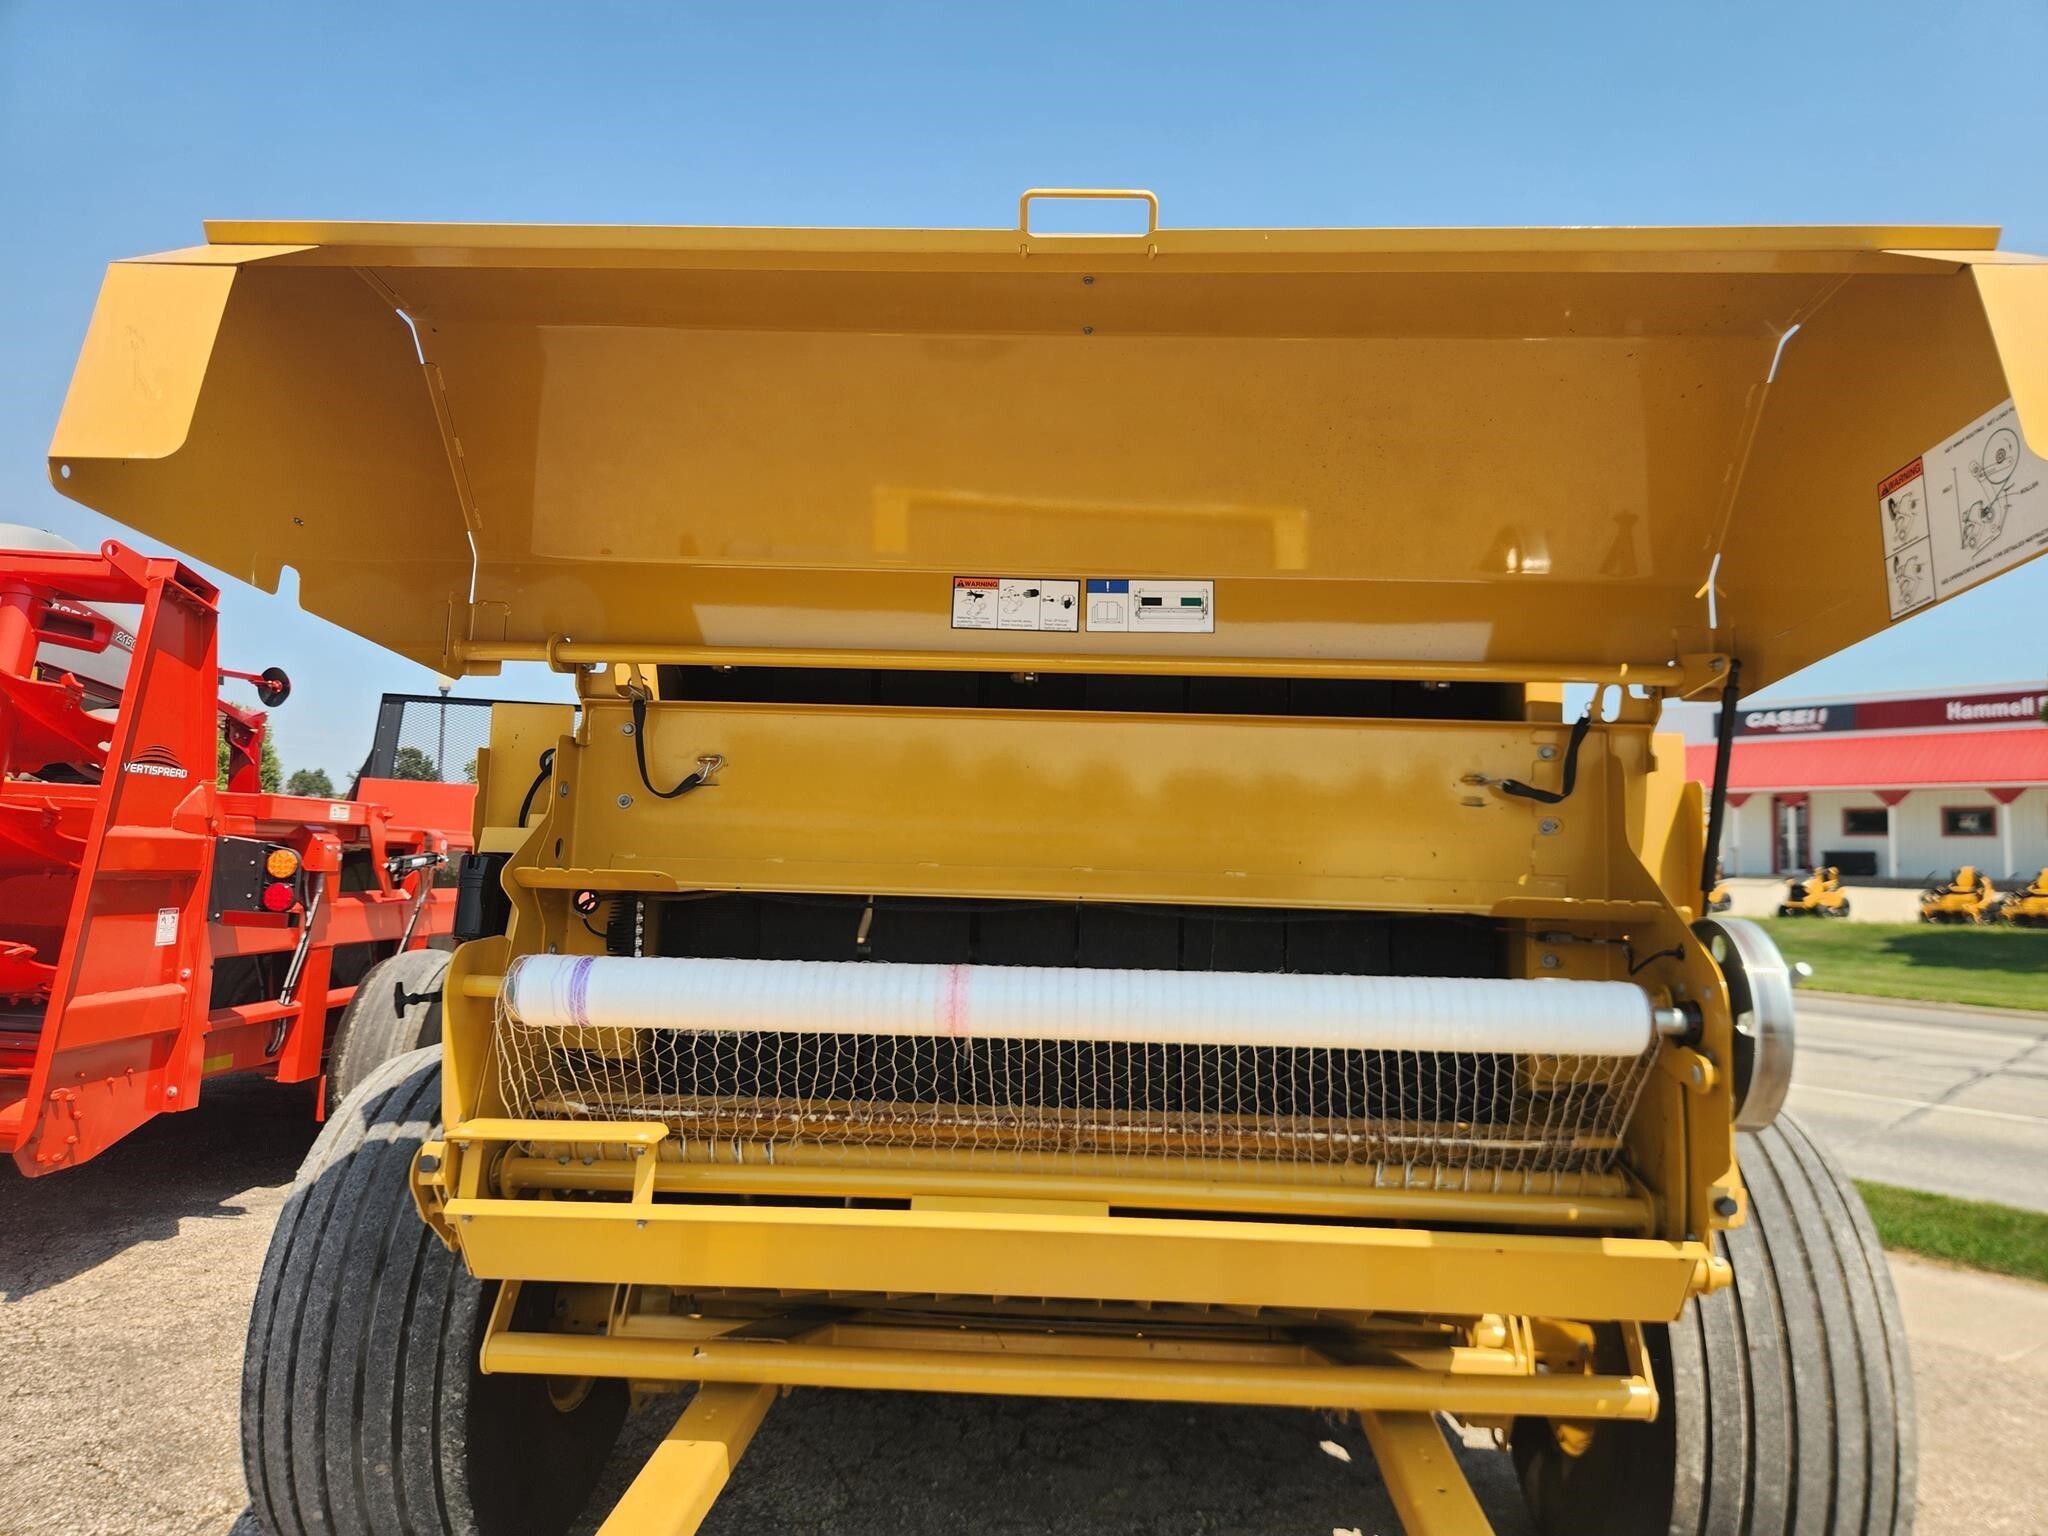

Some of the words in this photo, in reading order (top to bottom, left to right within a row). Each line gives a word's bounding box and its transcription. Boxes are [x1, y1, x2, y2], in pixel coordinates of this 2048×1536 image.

[964, 580, 998, 588] WARNING
[1946, 696, 2034, 720] Hammell
[123, 762, 188, 779] VERTISPREAD
